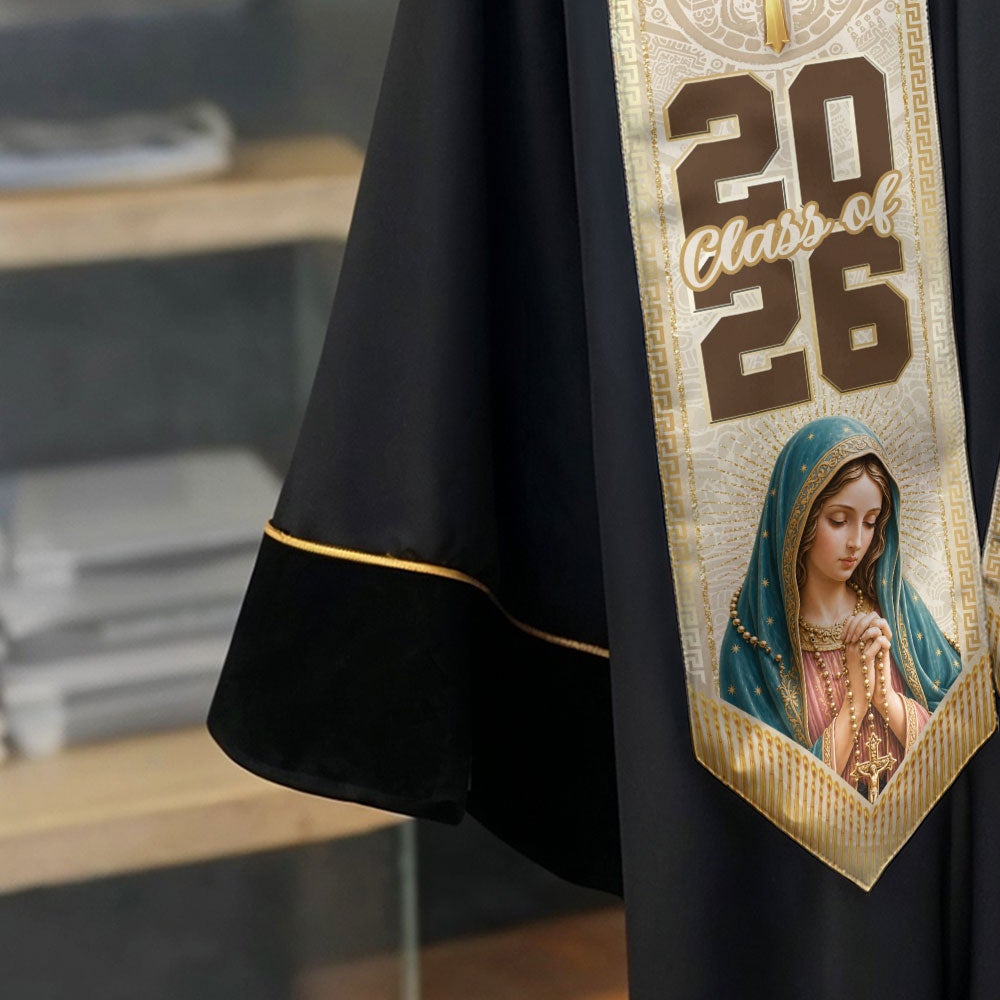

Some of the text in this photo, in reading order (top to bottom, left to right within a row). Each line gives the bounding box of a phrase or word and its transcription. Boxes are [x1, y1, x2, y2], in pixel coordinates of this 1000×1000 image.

[665, 55, 896, 240] 20
[680, 169, 903, 292] Class of
[690, 230, 914, 424] 26
